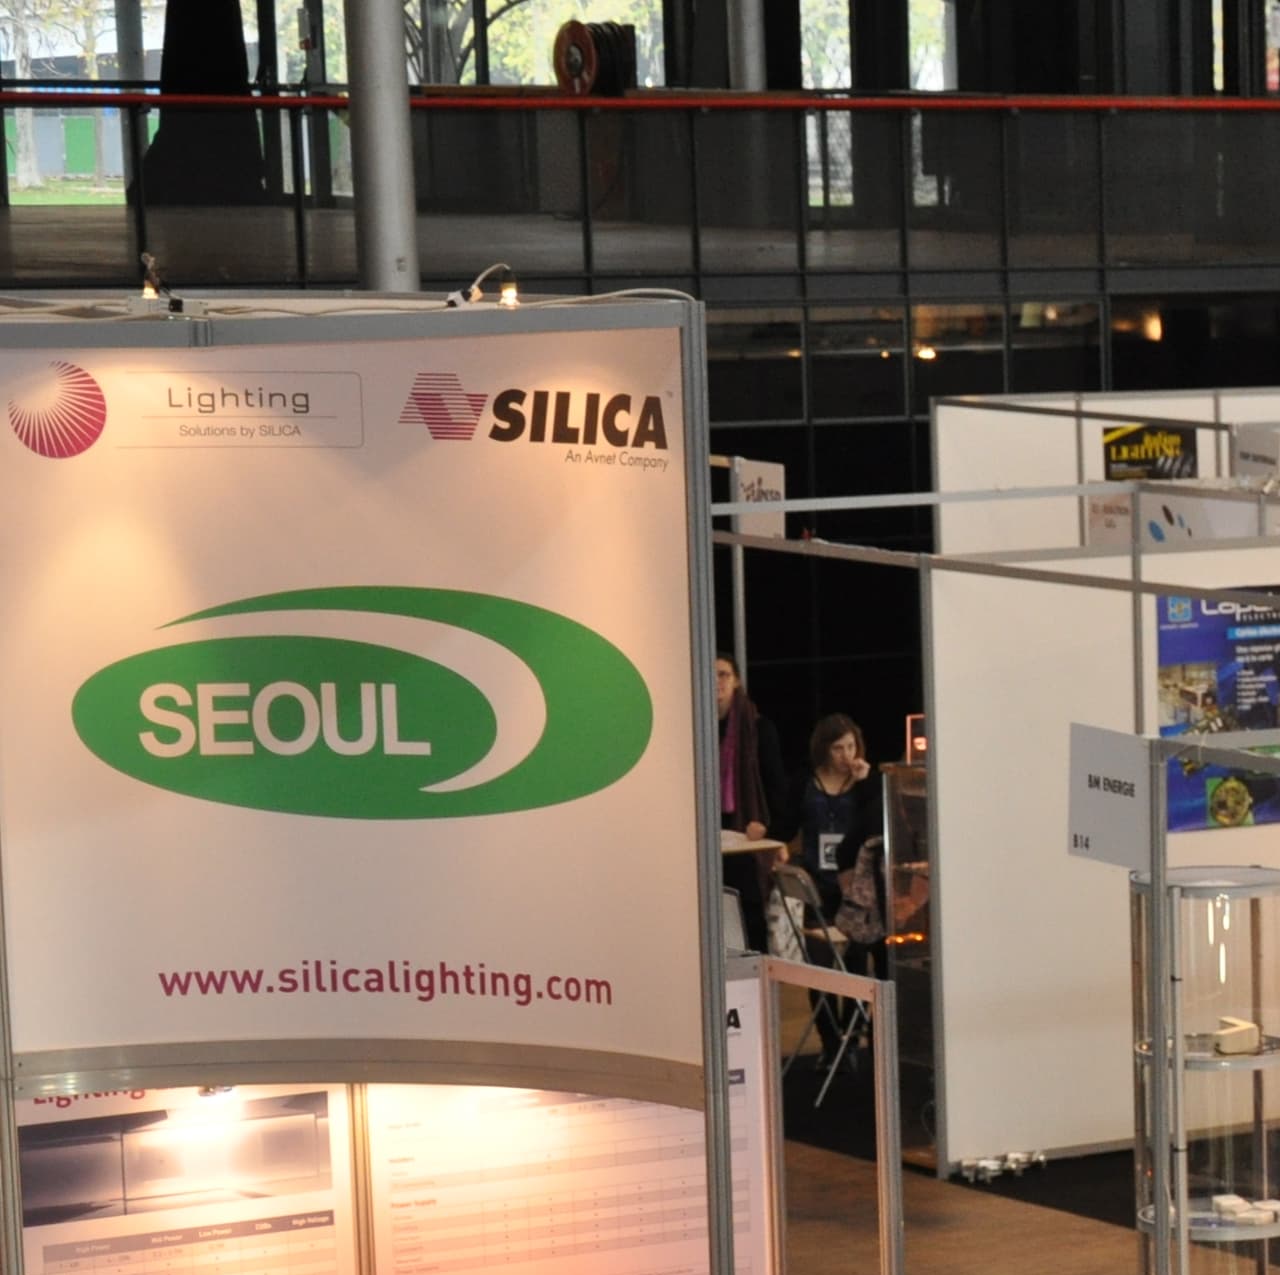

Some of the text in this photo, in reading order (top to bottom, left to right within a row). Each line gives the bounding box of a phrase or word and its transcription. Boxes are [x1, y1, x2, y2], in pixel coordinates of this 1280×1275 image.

[167, 386, 310, 414] Lighting
[179, 425, 302, 439] Solutions by SILICA
[488, 388, 669, 451] SILICA
[565, 451, 668, 472] An Avnet Company
[138, 682, 431, 757] SEOUL
[1103, 777, 1135, 798] ENERGIE
[158, 959, 613, 1006] www.silicalighting.com
